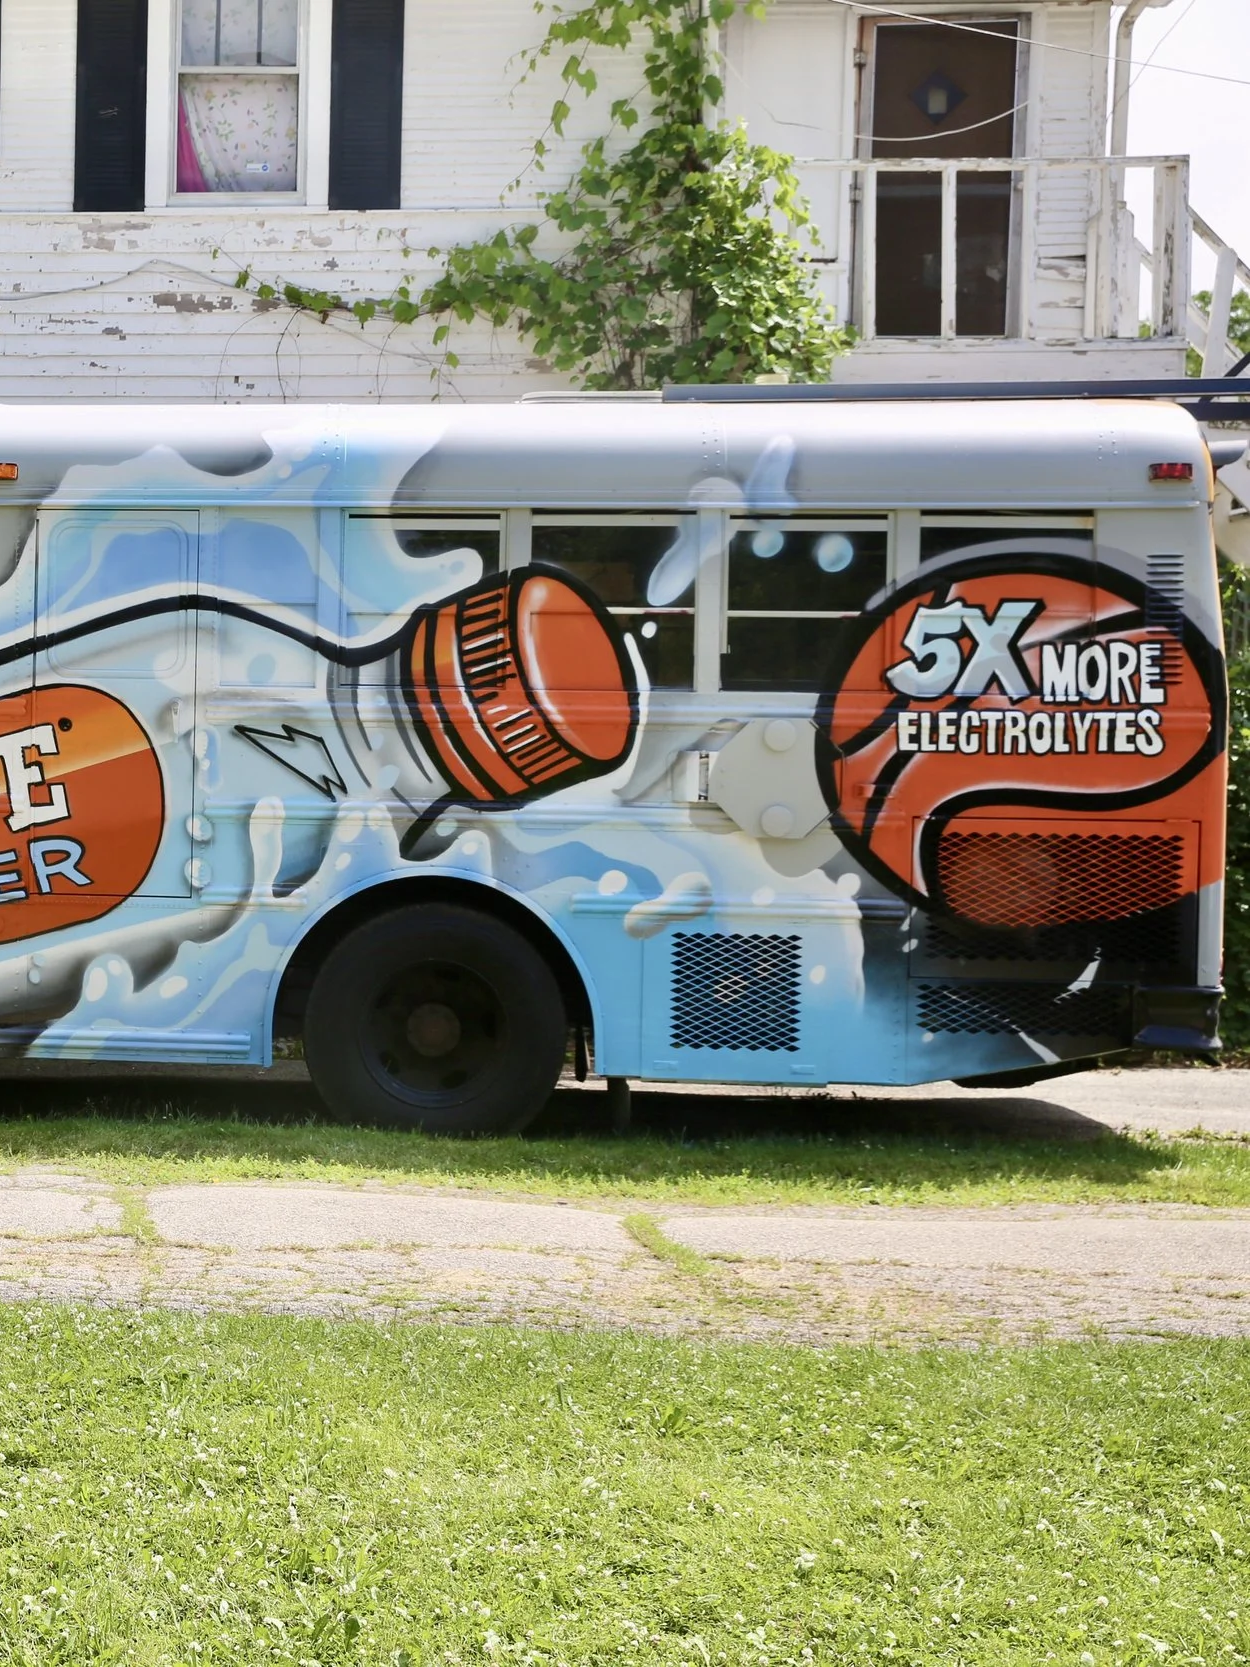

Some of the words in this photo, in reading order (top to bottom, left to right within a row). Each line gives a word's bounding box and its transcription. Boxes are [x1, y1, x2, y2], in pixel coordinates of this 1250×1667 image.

[885, 599, 1042, 701] 5X
[1040, 641, 1166, 704] MORE
[896, 709, 1166, 756] ELECTROLYTES
